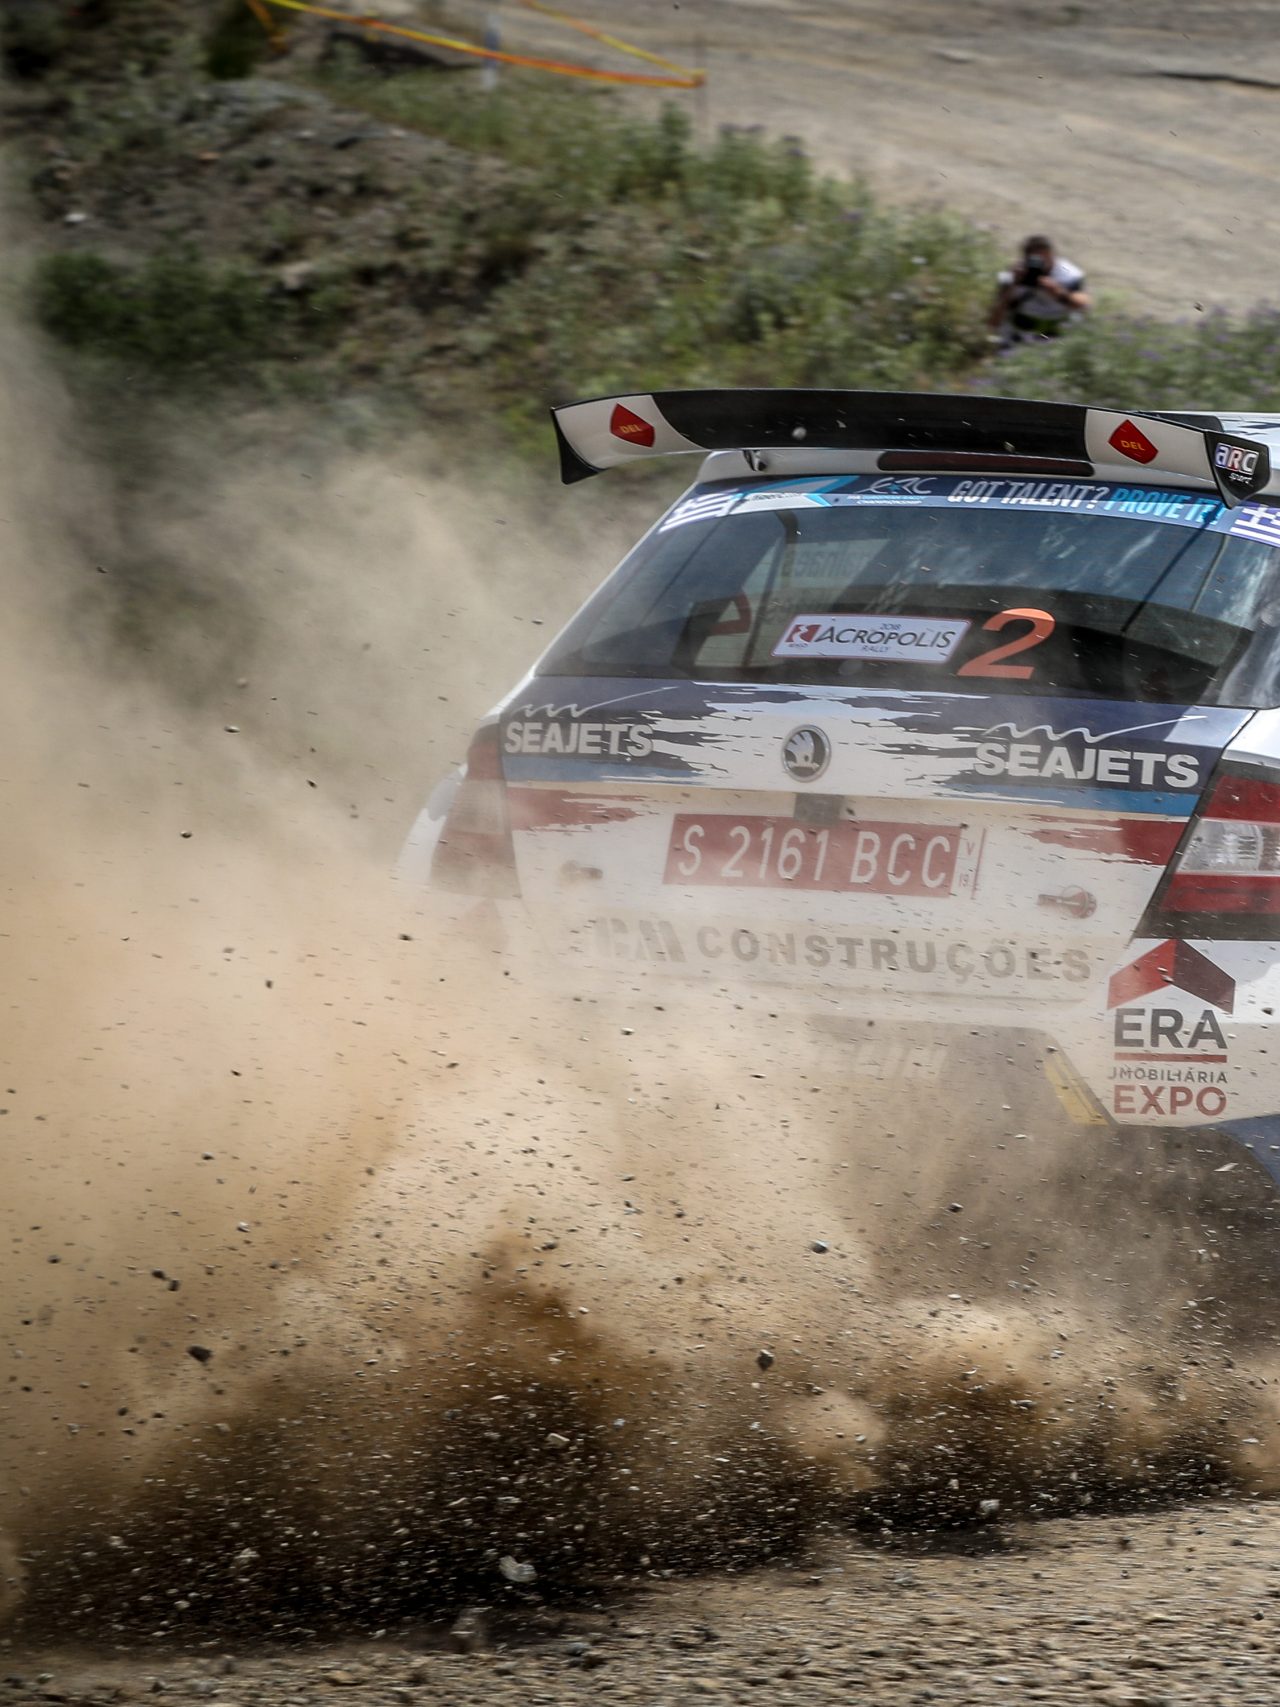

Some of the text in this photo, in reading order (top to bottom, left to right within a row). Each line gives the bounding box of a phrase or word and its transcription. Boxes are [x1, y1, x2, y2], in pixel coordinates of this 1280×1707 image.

[618, 423, 641, 434] DEL
[1120, 440, 1146, 451] DEL
[947, 480, 1004, 503] GOT
[1000, 482, 1111, 509] TALENT?
[1104, 487, 1182, 519] PROVE
[814, 626, 956, 649] ACROPOLIS
[957, 607, 1056, 680] 2
[504, 721, 655, 758] SEAJETS
[974, 742, 1199, 789] SEAJETS
[678, 824, 950, 889] S 2161 BCC
[697, 924, 1092, 984] CONSTRUÇÕES
[1113, 1008, 1229, 1050] ERA
[1112, 1065, 1229, 1085] IMOBILIÁRIA
[1113, 1085, 1228, 1117] EXPO
